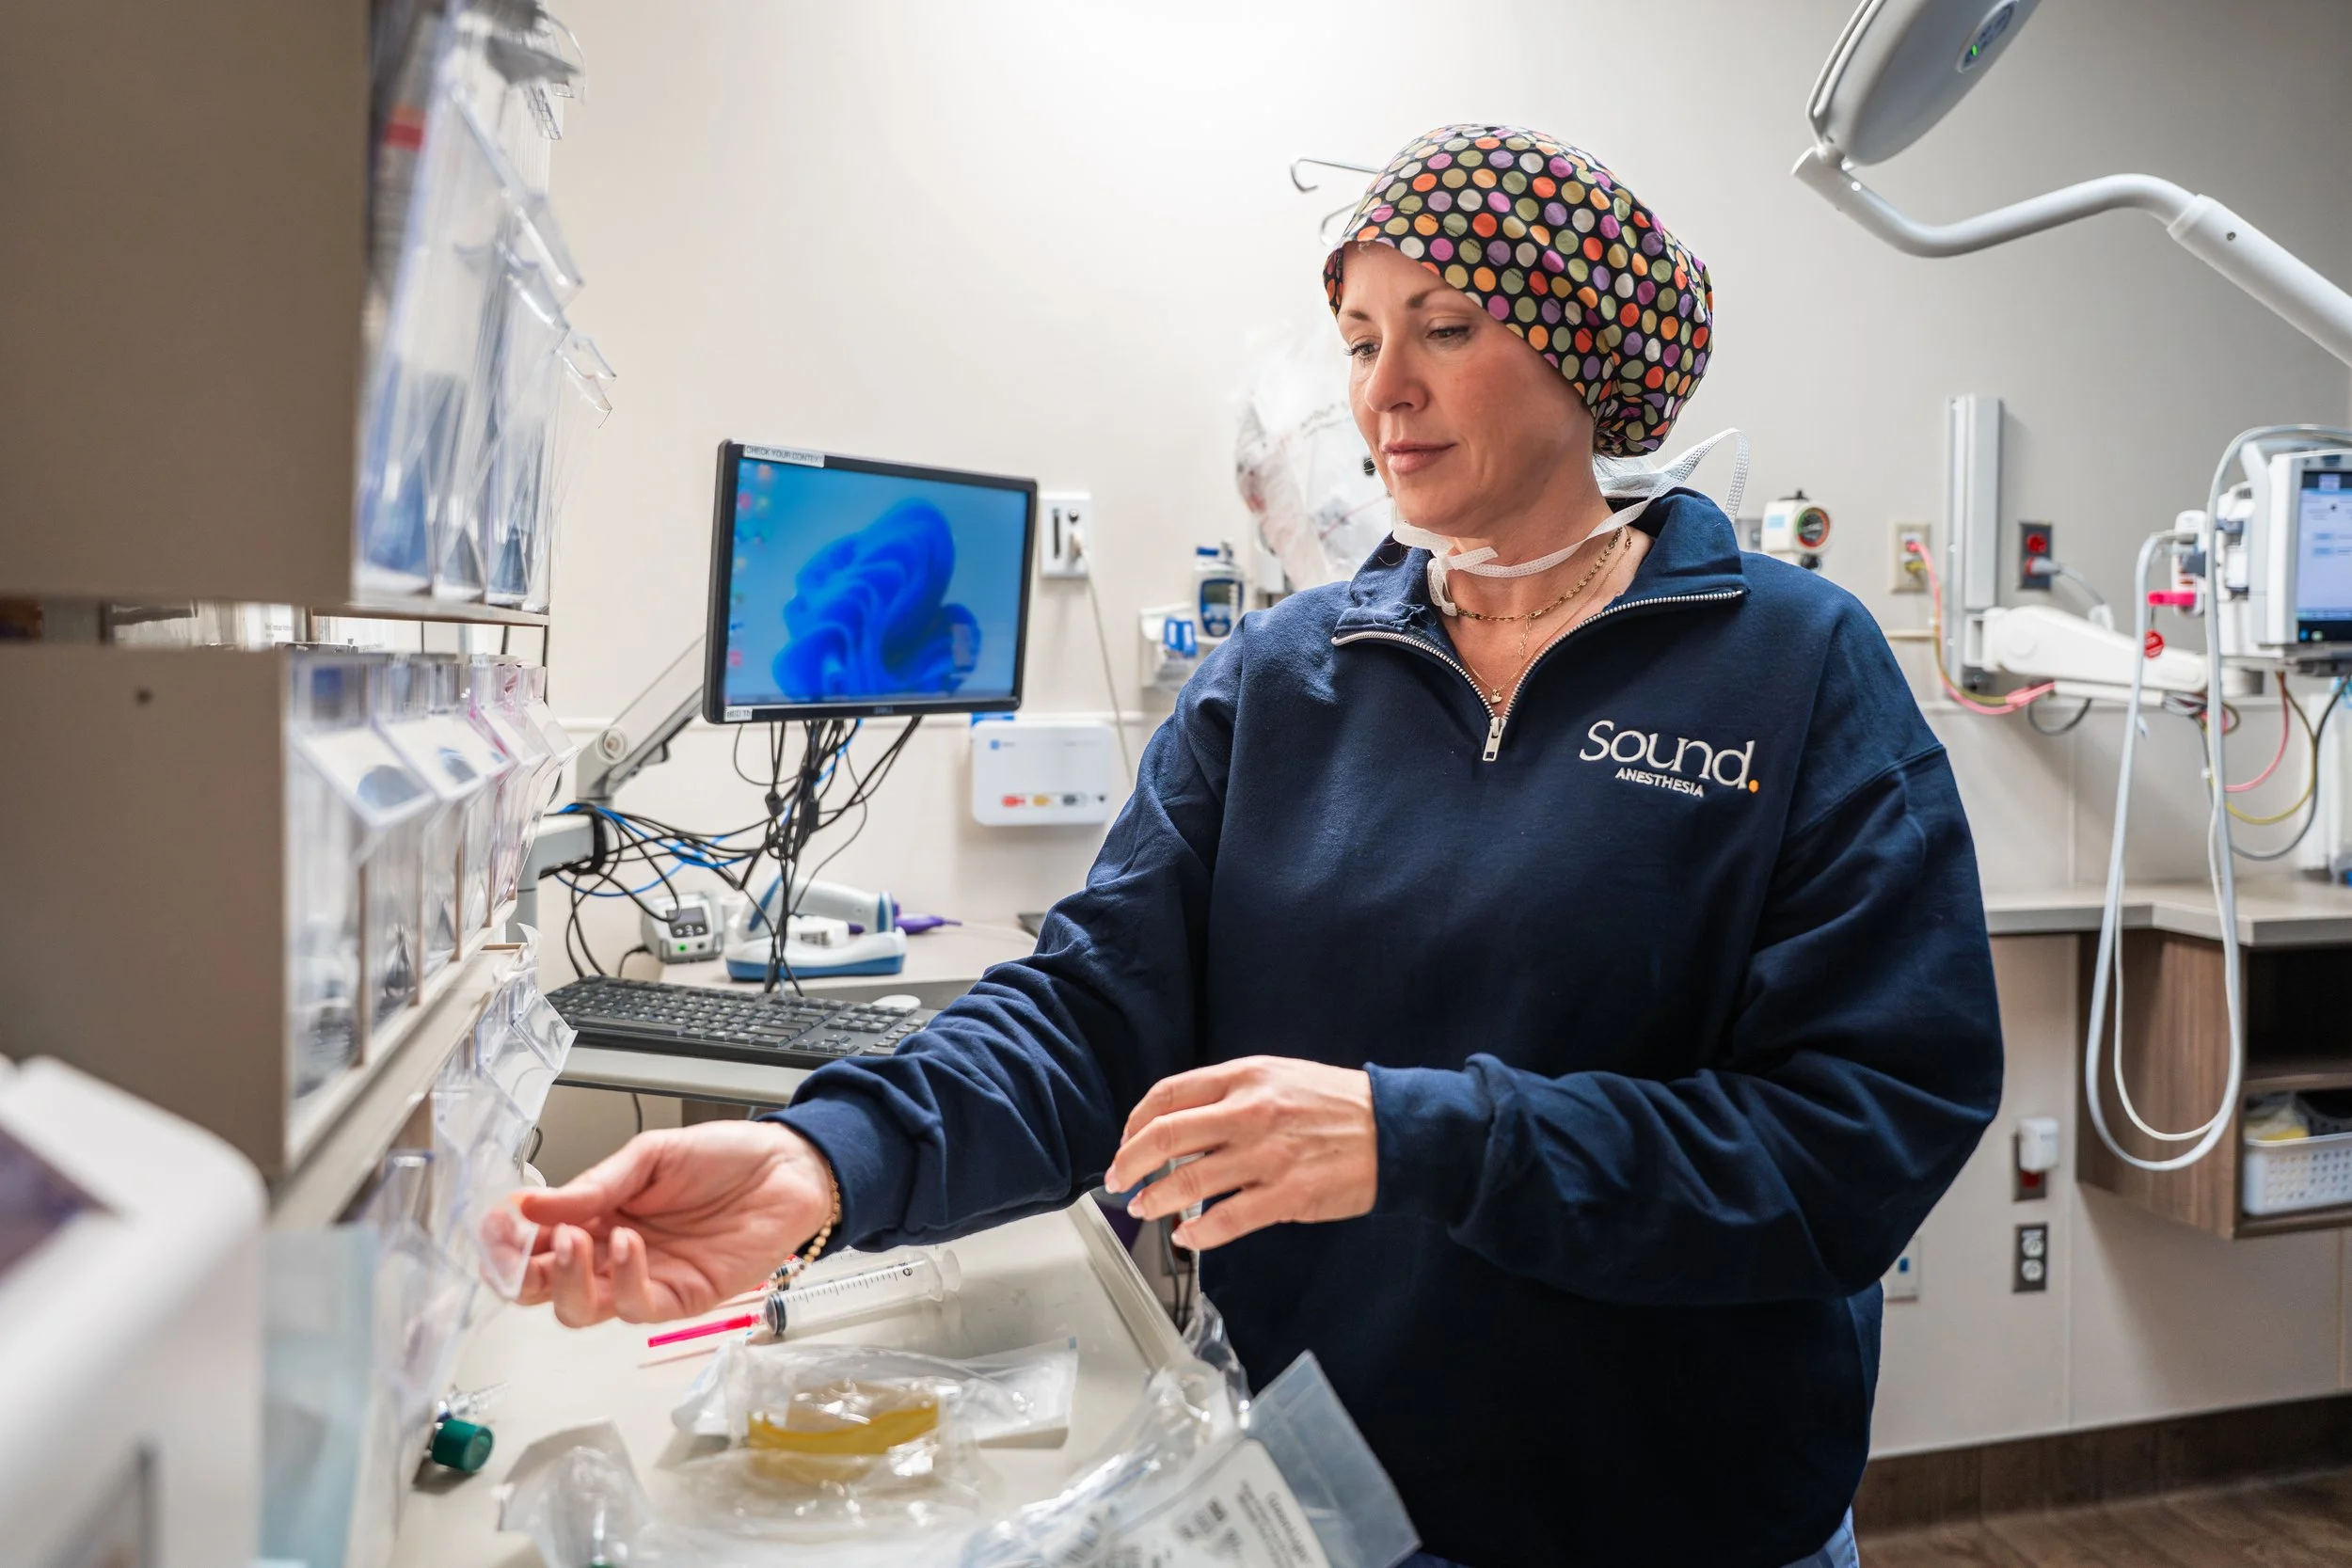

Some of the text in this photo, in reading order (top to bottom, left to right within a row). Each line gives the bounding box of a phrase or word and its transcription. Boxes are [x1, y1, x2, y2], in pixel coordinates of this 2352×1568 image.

[746, 445, 770, 455] CHECK
[771, 450, 792, 458] YOUR
[1615, 767, 1705, 798] ANESTHESIA
